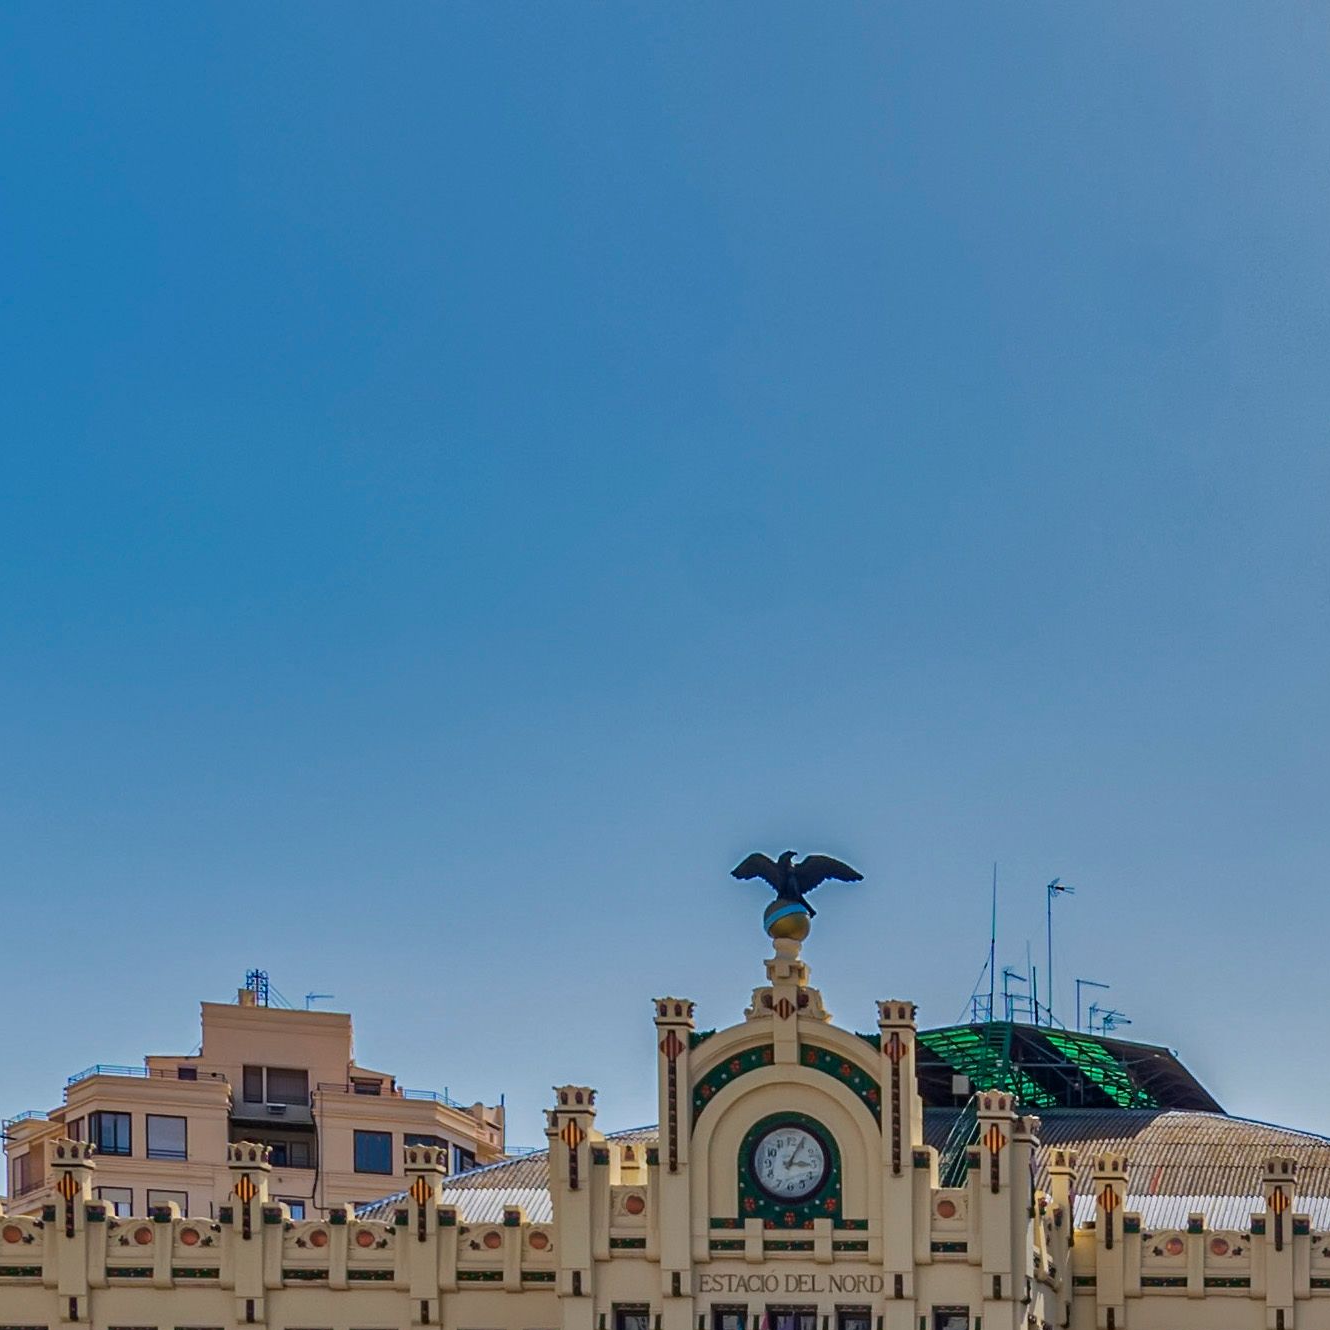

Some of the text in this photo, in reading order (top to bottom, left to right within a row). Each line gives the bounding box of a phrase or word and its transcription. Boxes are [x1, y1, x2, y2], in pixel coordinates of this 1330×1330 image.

[786, 1136, 797, 1147] 12
[767, 1148, 777, 1158] 10
[764, 1159, 772, 1168] 9
[767, 1169, 774, 1179] 8
[806, 1171, 813, 1180] 4
[776, 1179, 782, 1188] 7
[787, 1182, 794, 1191] 6
[798, 1180, 806, 1189] 5
[699, 1269, 884, 1294] ESTACIÓ DEL NORD
